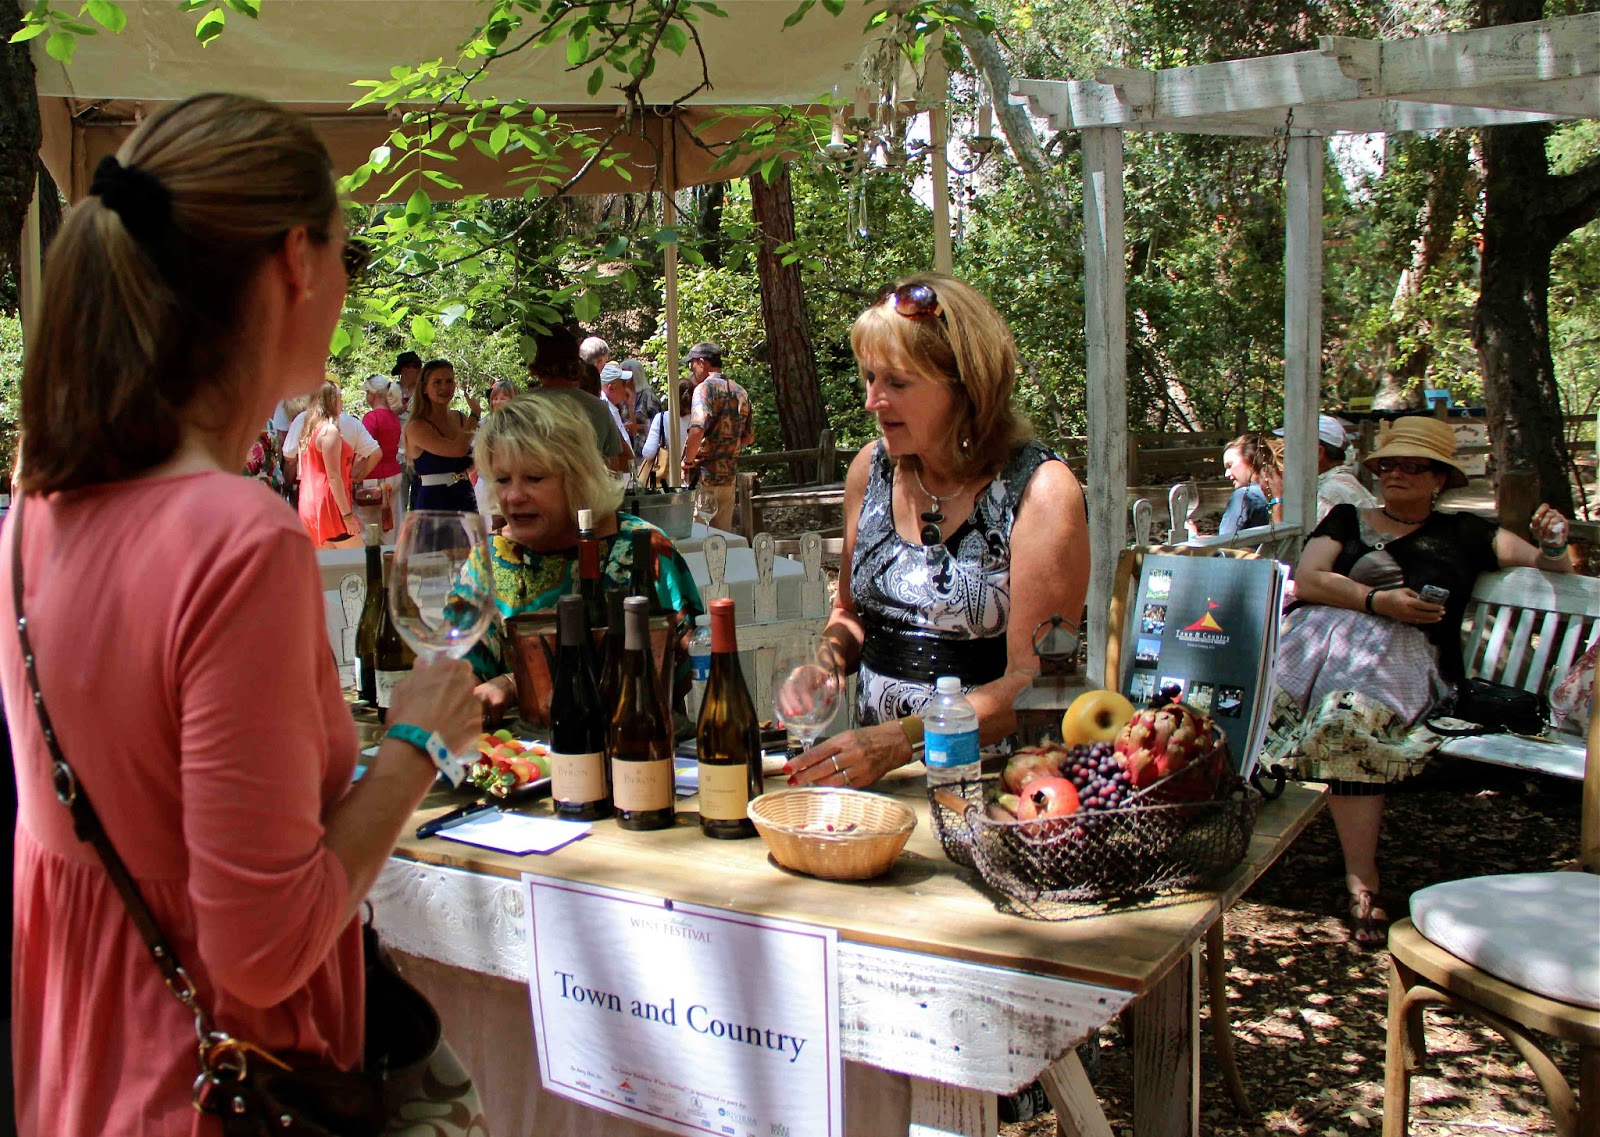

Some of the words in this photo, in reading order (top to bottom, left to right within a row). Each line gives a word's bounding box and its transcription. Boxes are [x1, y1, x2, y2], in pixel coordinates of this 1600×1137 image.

[1176, 629, 1193, 638] Town
[1203, 632, 1230, 643] Country
[557, 766, 588, 777] BYRON
[624, 774, 656, 784] BYRON
[664, 923, 712, 943] FESTIVAL
[554, 971, 622, 1012] Town
[631, 998, 677, 1027] and
[686, 1004, 807, 1063] Country
